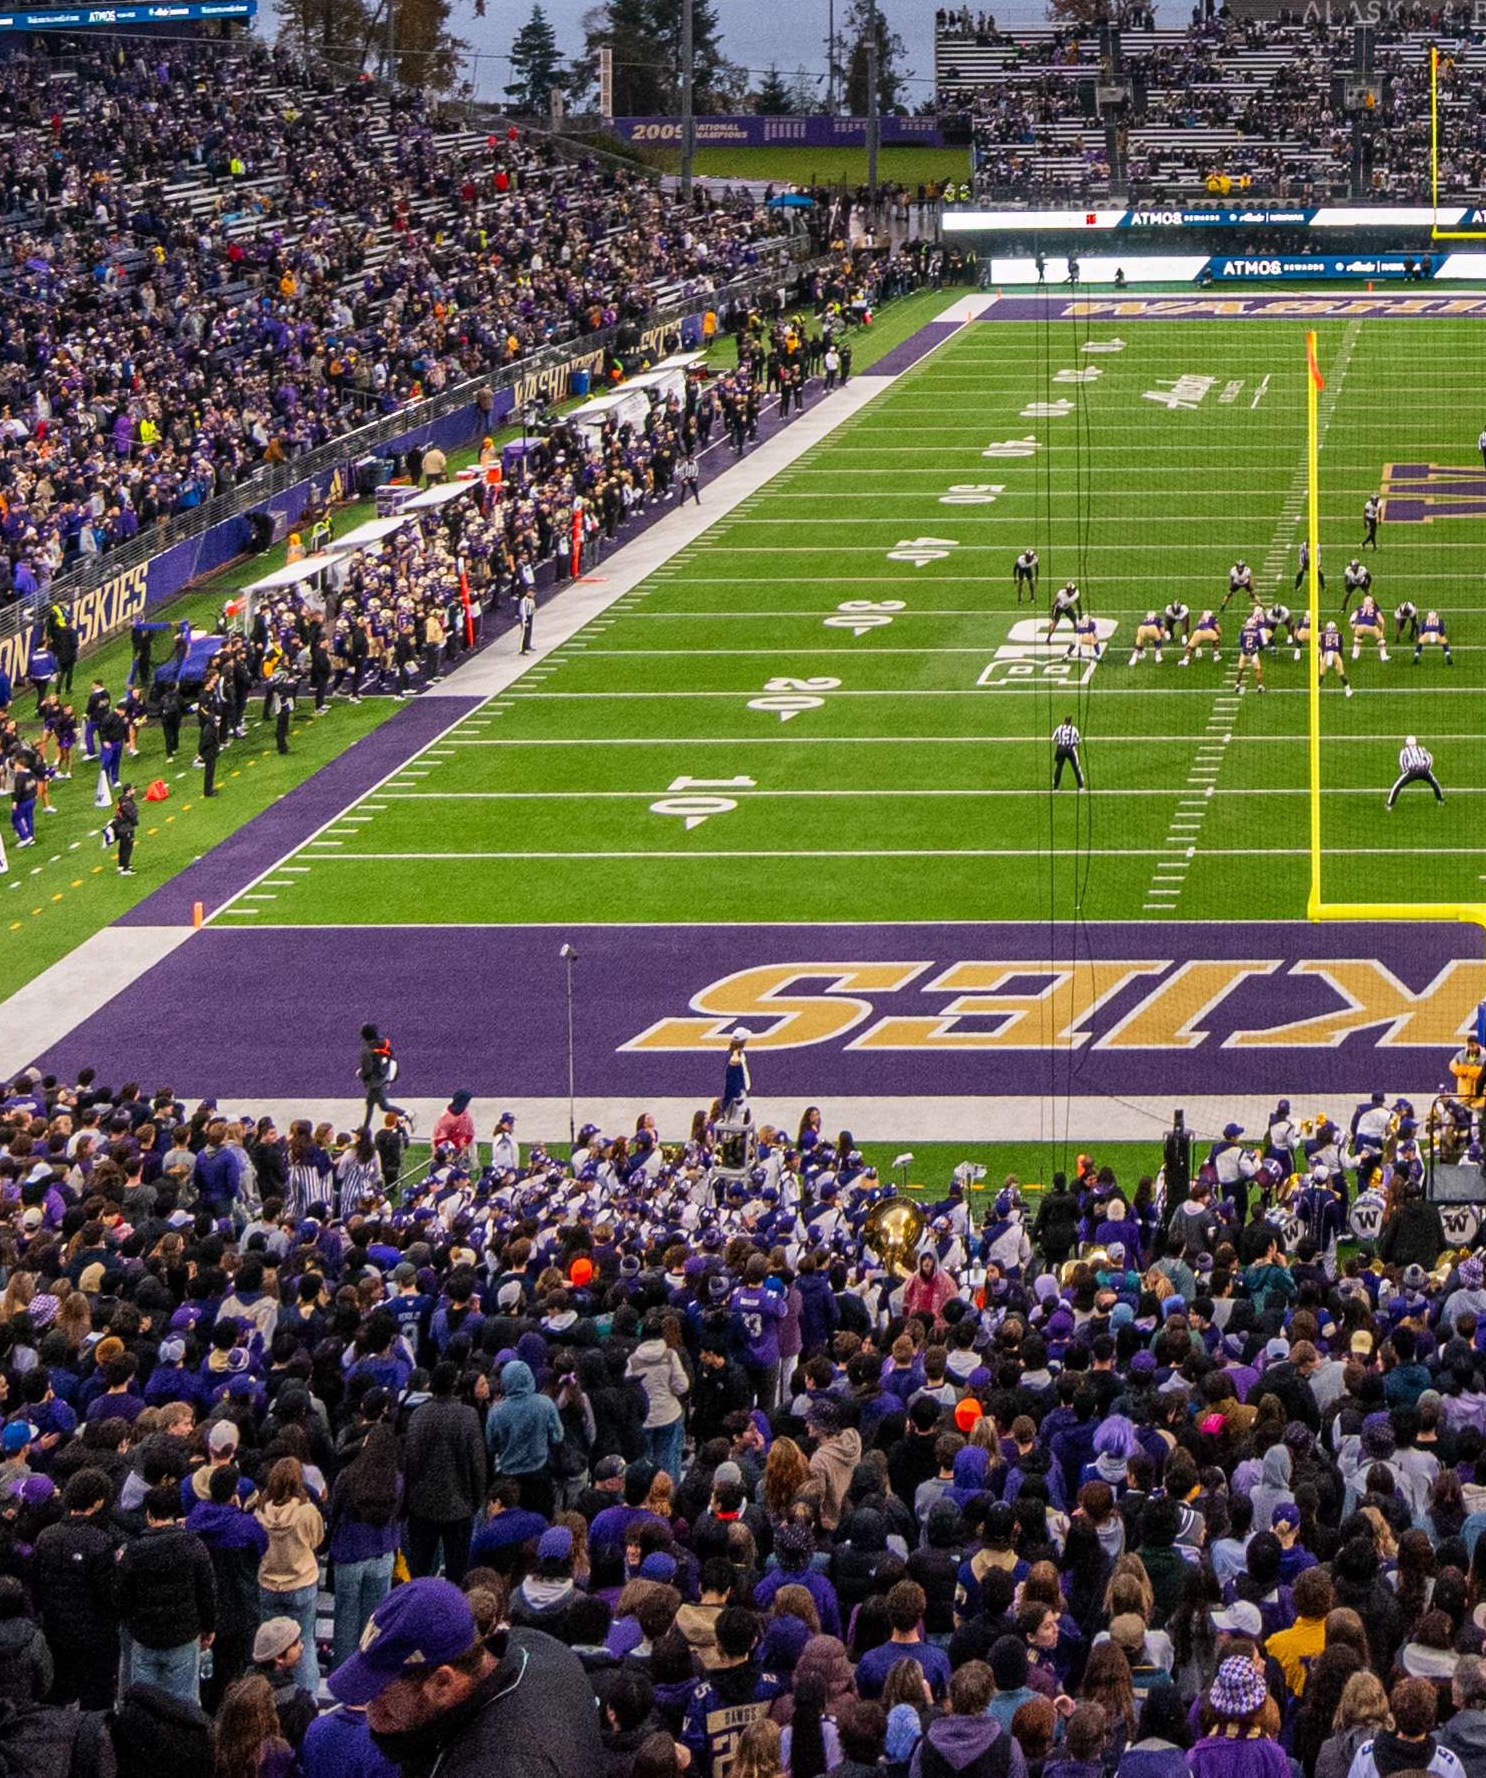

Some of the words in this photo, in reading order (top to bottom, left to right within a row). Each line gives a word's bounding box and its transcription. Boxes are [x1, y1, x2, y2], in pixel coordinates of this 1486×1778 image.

[1131, 212, 1182, 225] ATMOS
[1223, 261, 1282, 277] ATMOS
[938, 484, 1006, 504] 50
[886, 537, 959, 560] 40
[823, 600, 907, 627] 30
[746, 676, 842, 711] 20
[649, 775, 757, 815] 10
[1355, 1210, 1379, 1231] W
[1445, 1211, 1468, 1232] W
